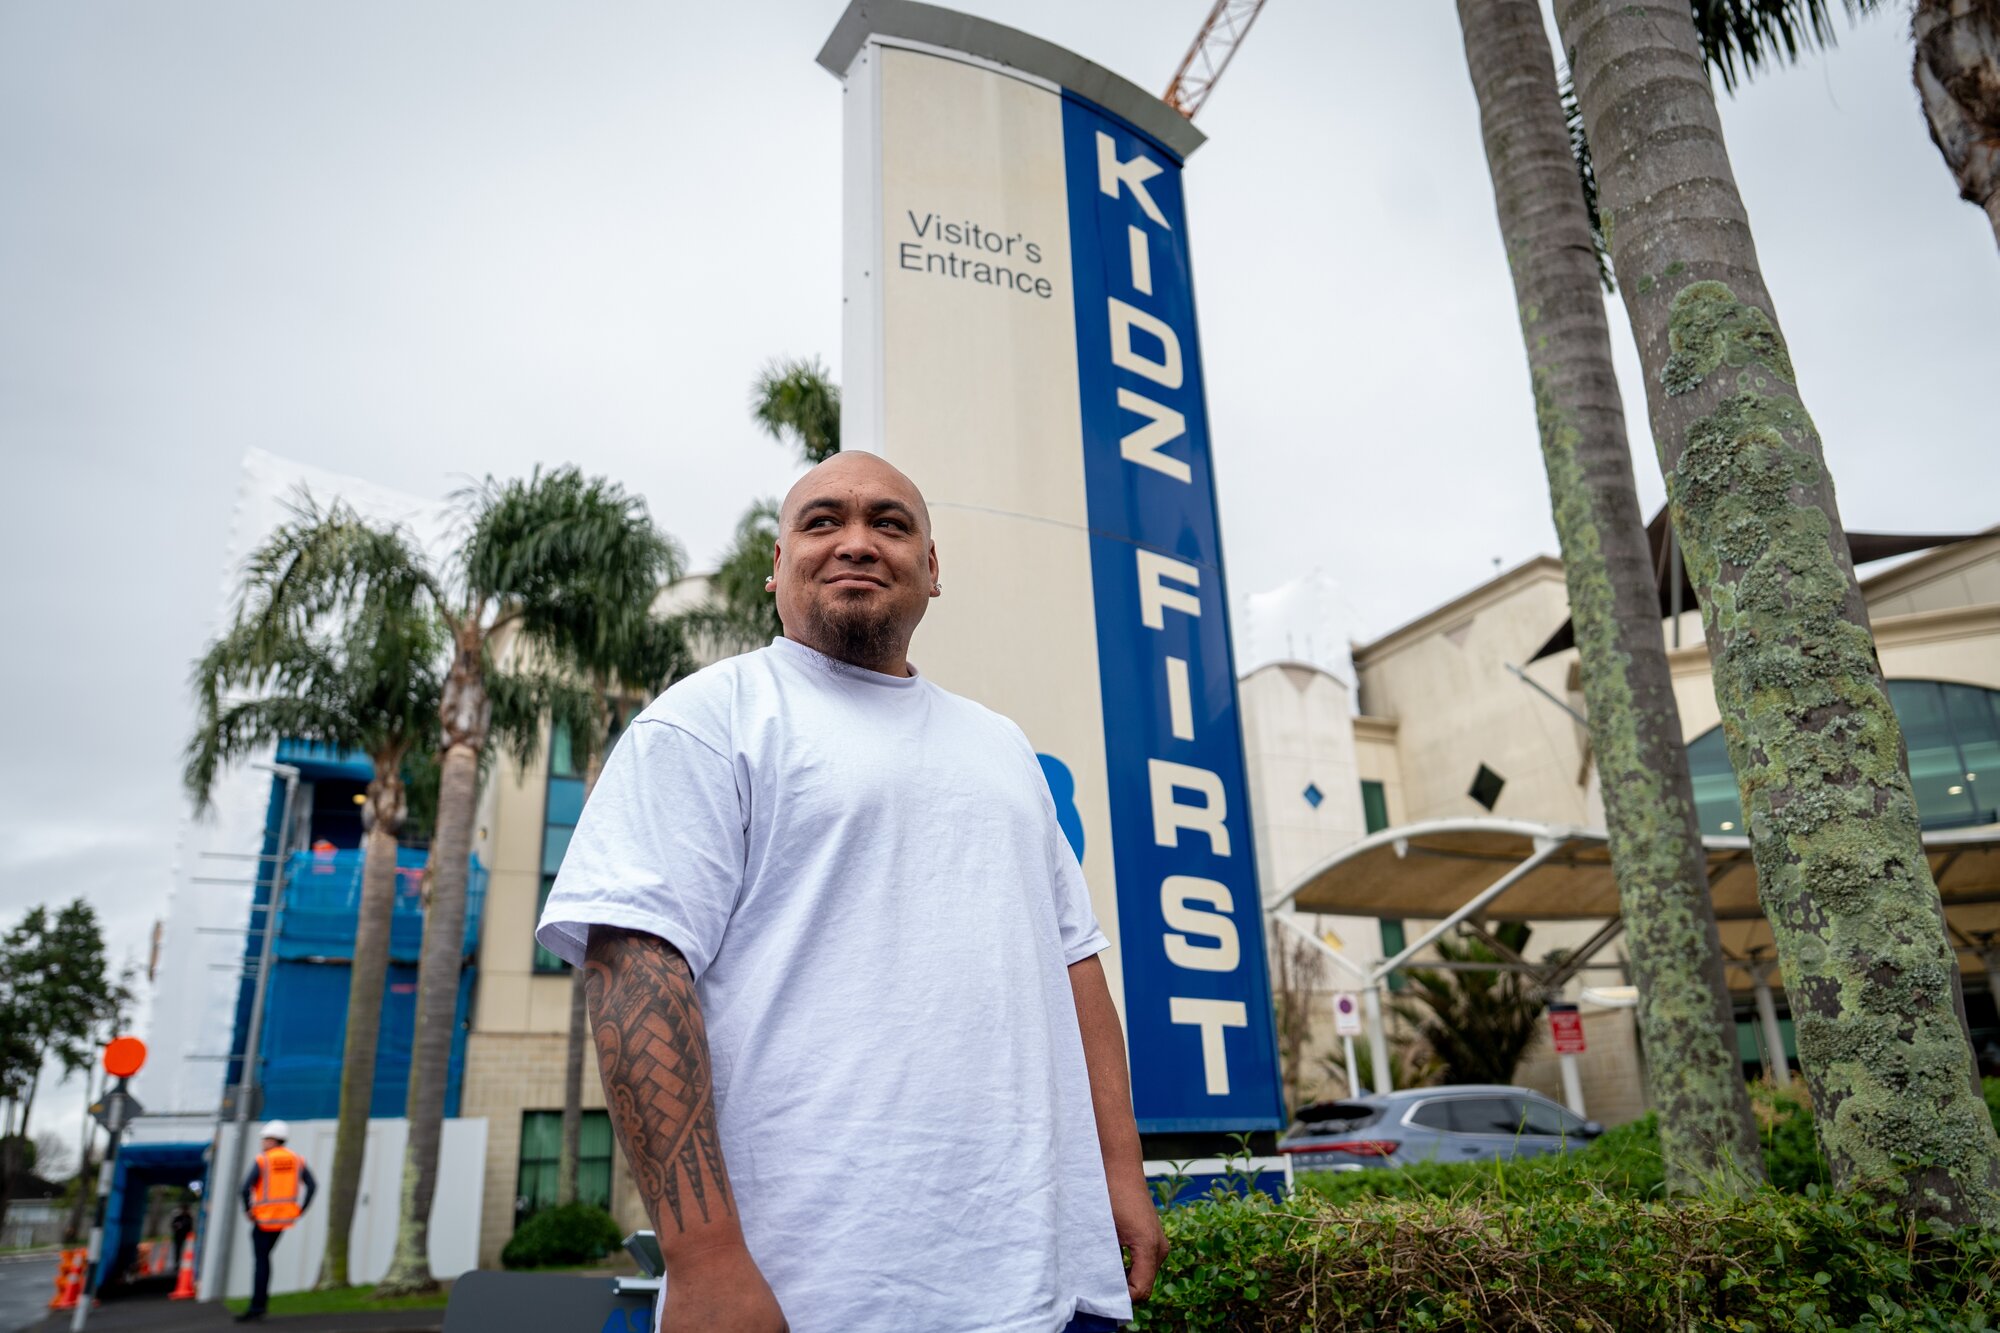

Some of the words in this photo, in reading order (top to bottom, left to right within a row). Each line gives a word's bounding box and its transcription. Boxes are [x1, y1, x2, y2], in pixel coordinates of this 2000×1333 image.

[900, 243, 1053, 299] Entrance
[907, 210, 1042, 265] Visitor's
[1096, 131, 1192, 484] KIDZ
[1137, 549, 1247, 1097] FIRST
